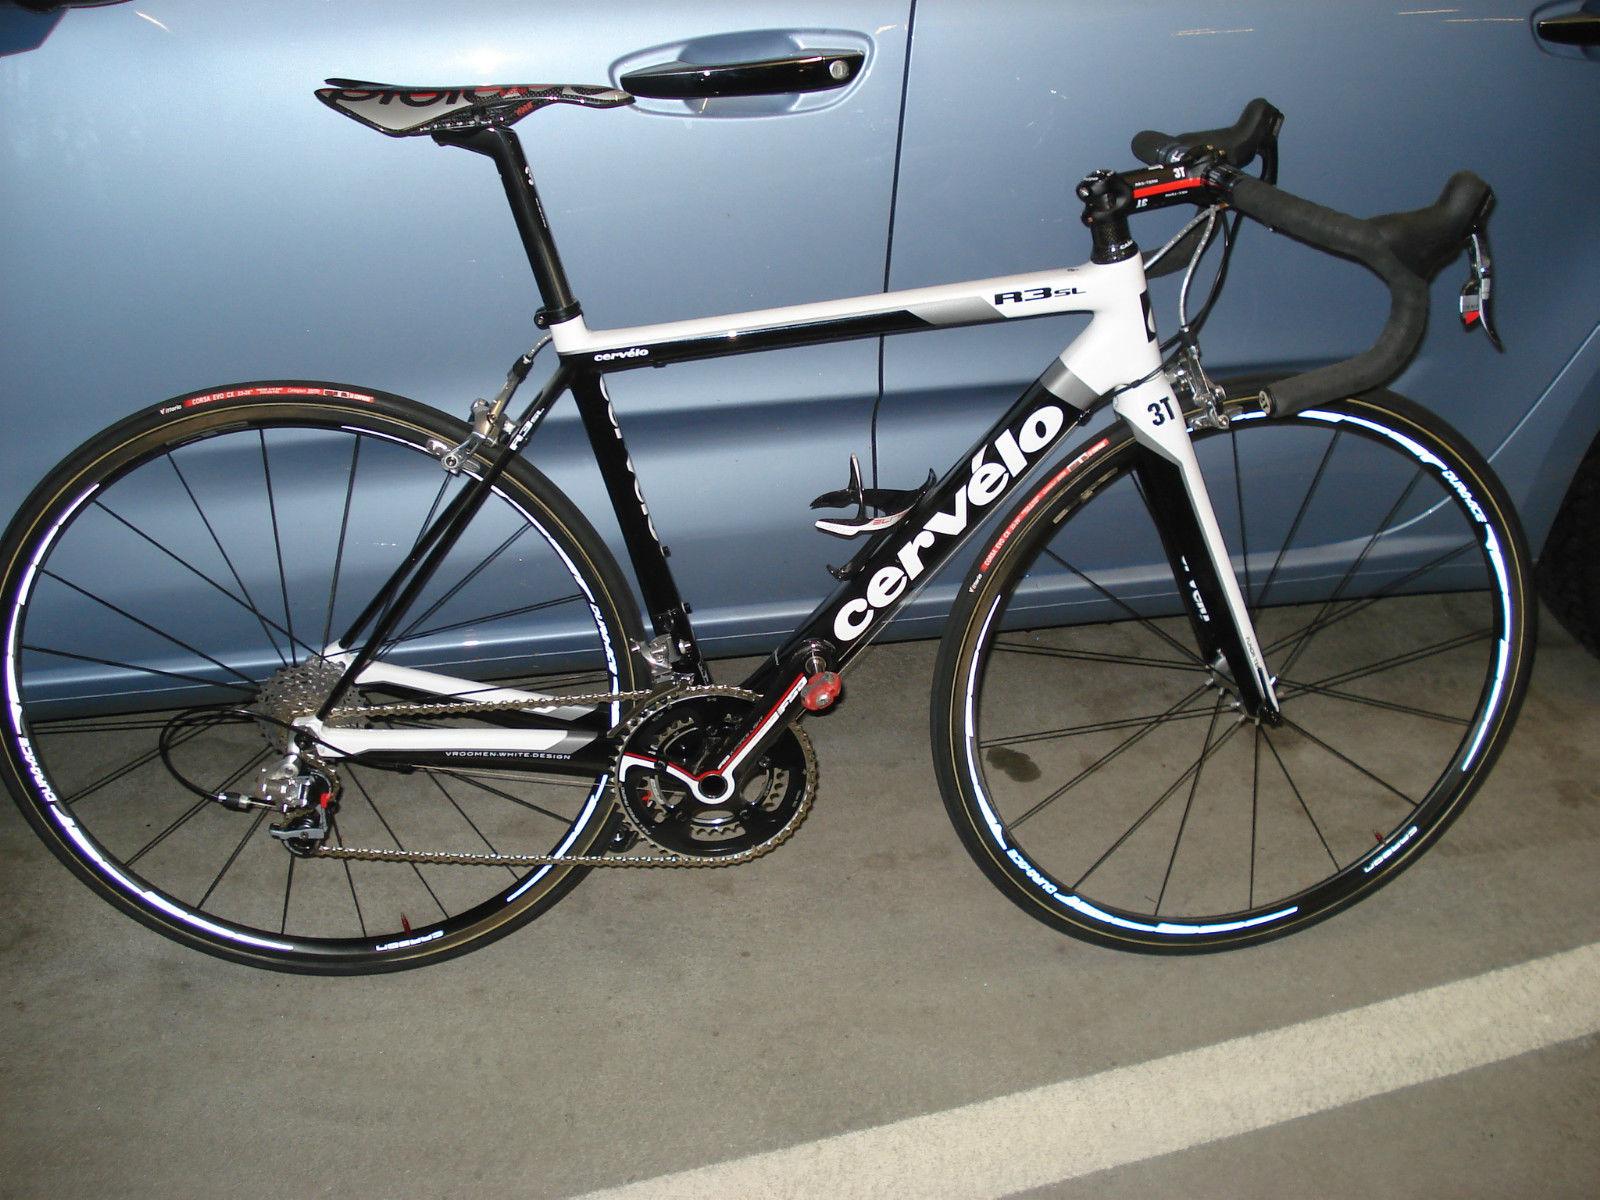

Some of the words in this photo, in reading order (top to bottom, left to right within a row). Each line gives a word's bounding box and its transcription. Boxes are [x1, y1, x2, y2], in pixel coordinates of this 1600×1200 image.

[1172, 166, 1186, 179] 3T
[594, 348, 649, 362] cervélo
[192, 395, 211, 406] CORSA
[212, 392, 224, 401] EVO
[1147, 396, 1176, 427] 3T
[833, 405, 1064, 641] cervélo
